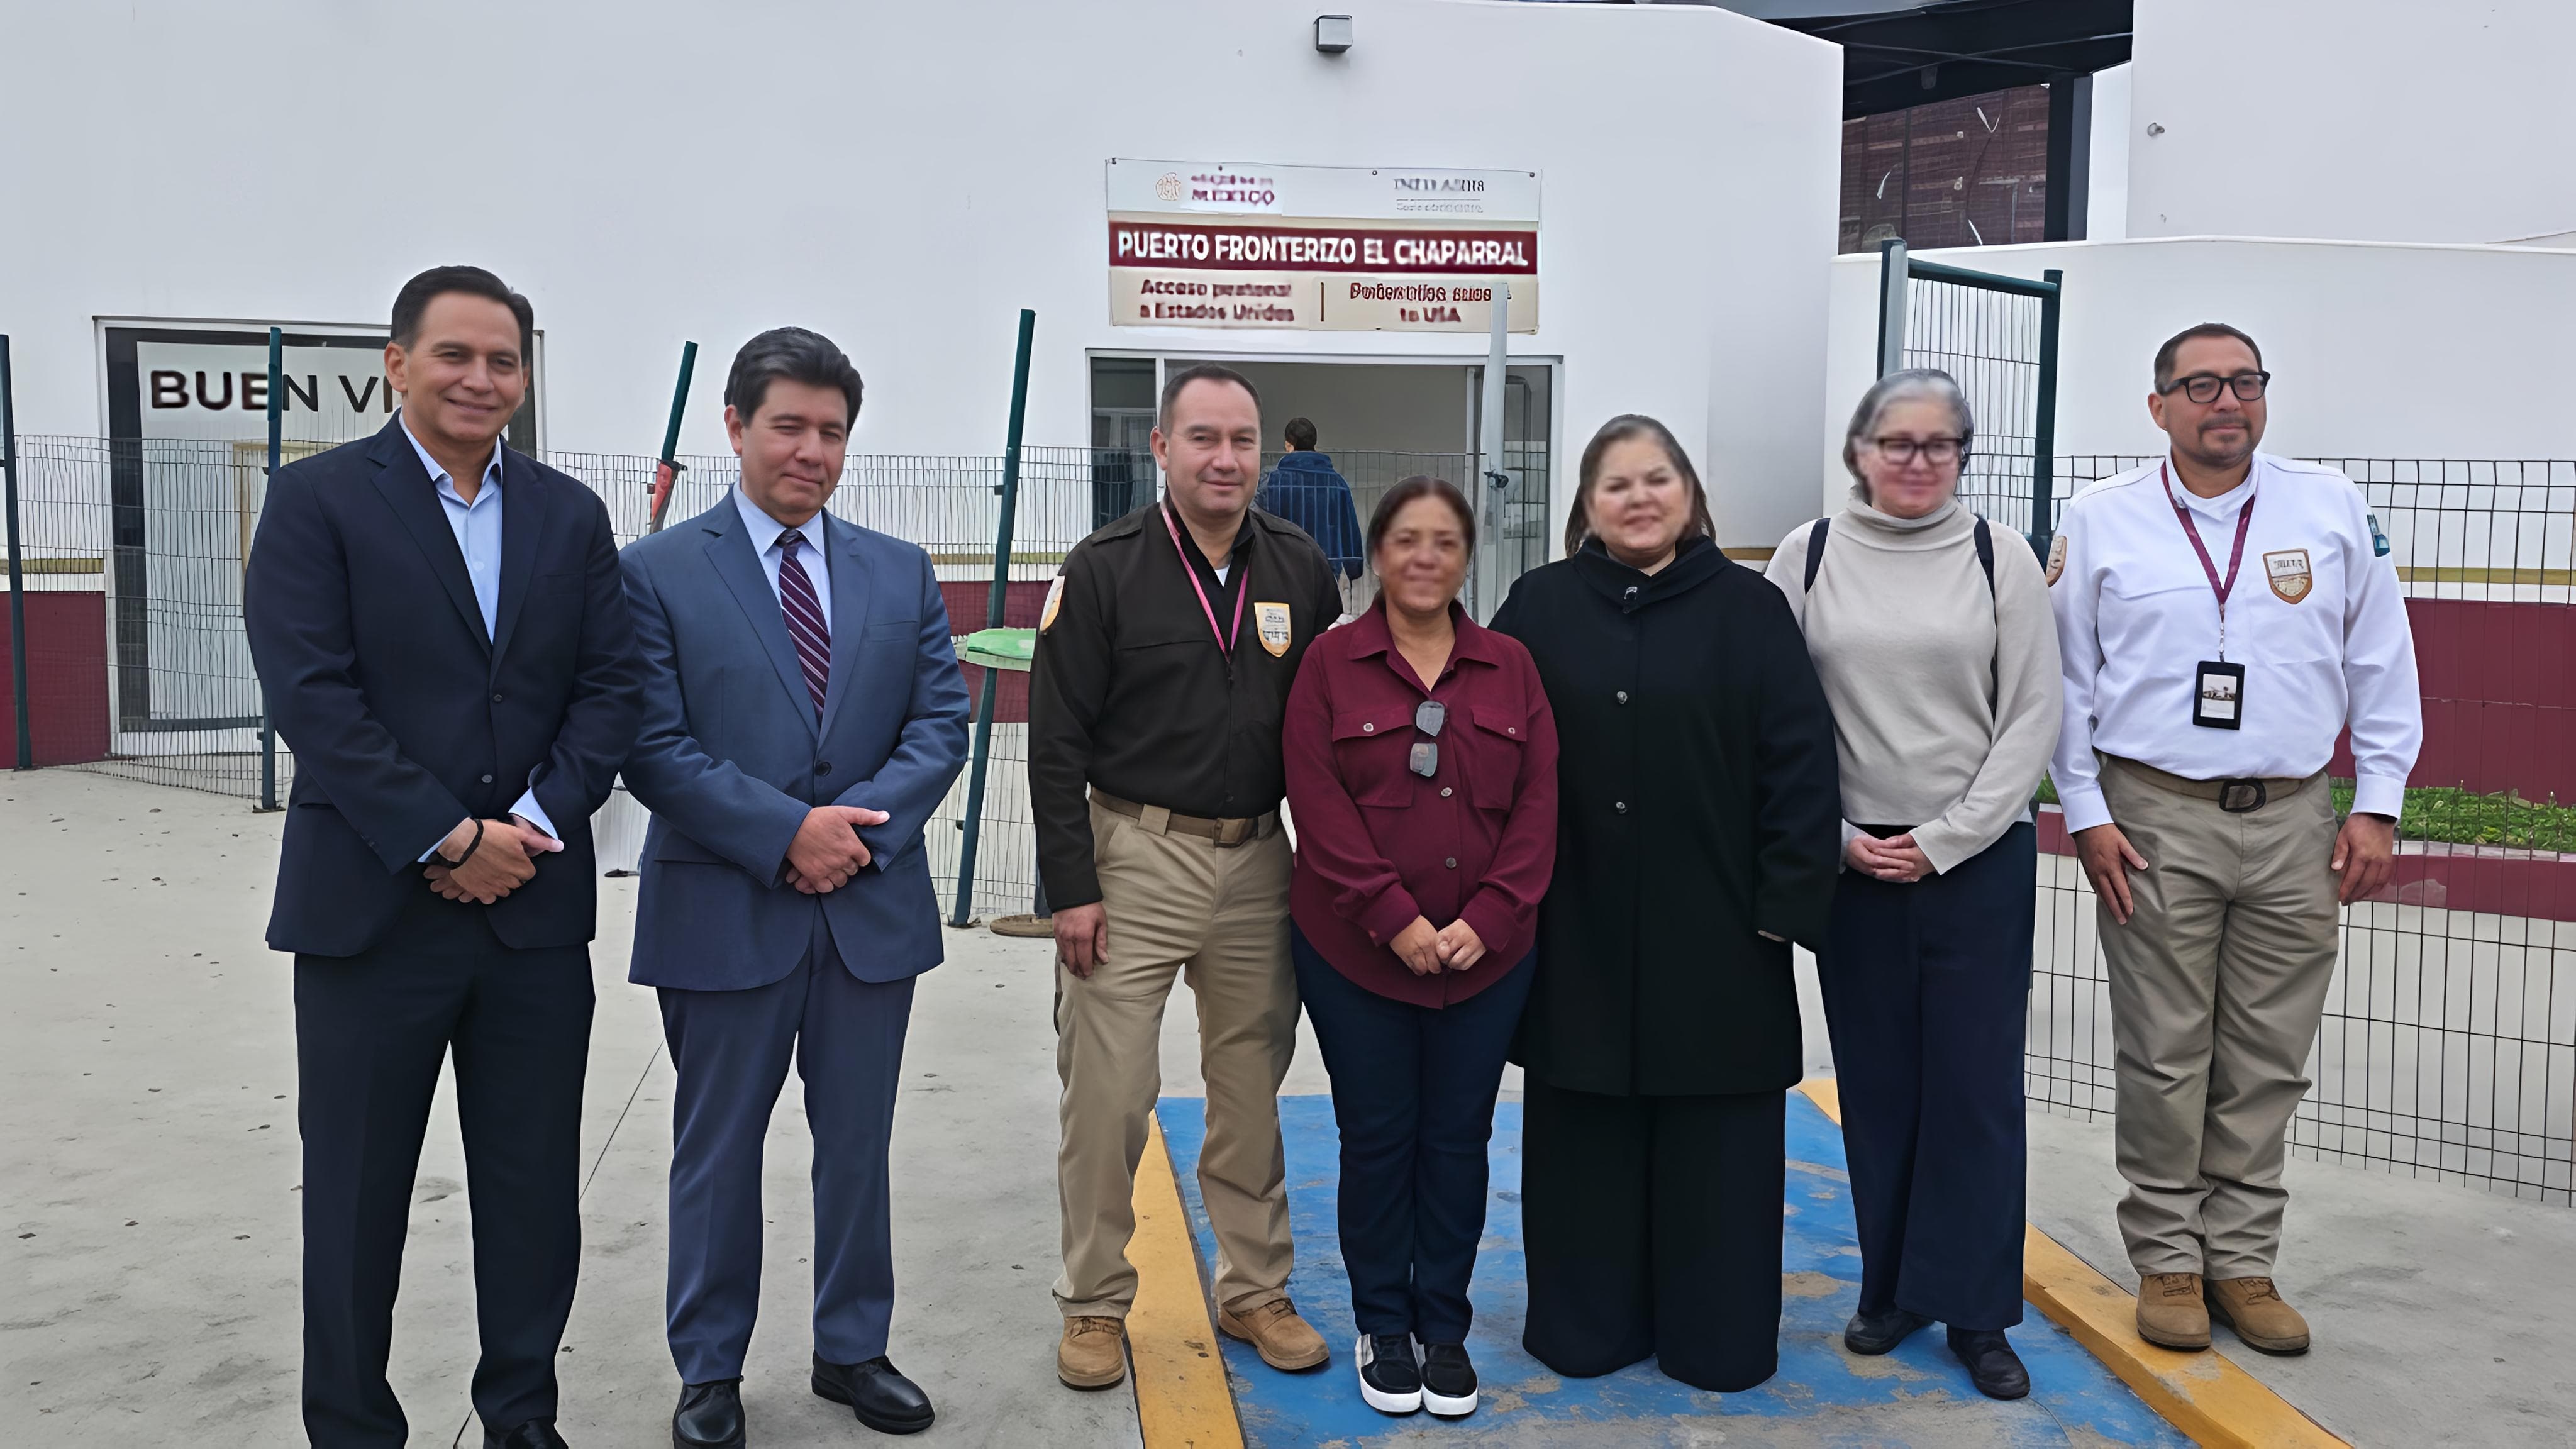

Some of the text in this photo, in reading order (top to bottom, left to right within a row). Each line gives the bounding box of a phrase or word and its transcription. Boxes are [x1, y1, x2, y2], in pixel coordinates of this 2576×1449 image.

[1118, 231, 1529, 266] PUERTO FRONTERIZO EL CHAPARRAL
[150, 370, 318, 412] BUEN
